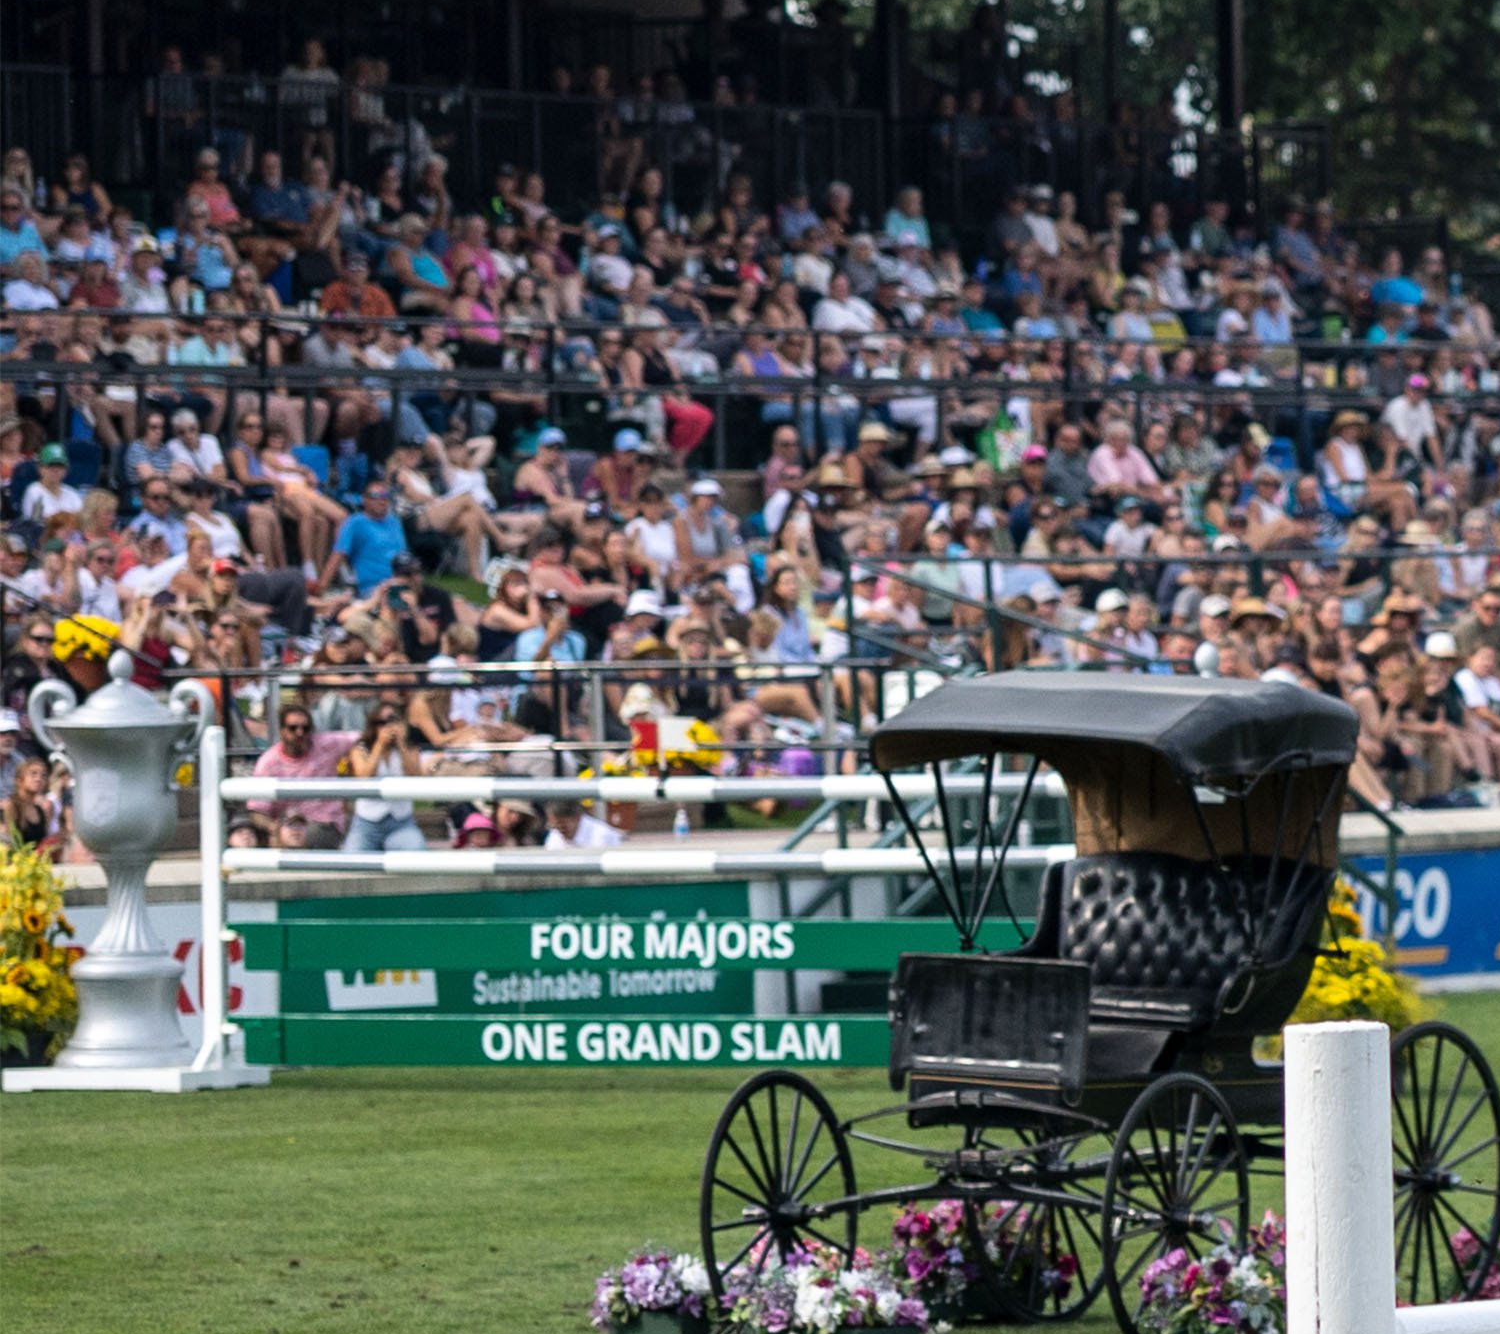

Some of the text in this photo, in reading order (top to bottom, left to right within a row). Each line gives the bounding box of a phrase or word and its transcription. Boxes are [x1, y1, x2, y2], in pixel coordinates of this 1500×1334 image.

[530, 922, 795, 968] FOUR MAJORS
[472, 970, 601, 1005] Sustainable
[607, 968, 717, 997] Tomorrow
[481, 1022, 842, 1061] ONE GRAND SLAM
